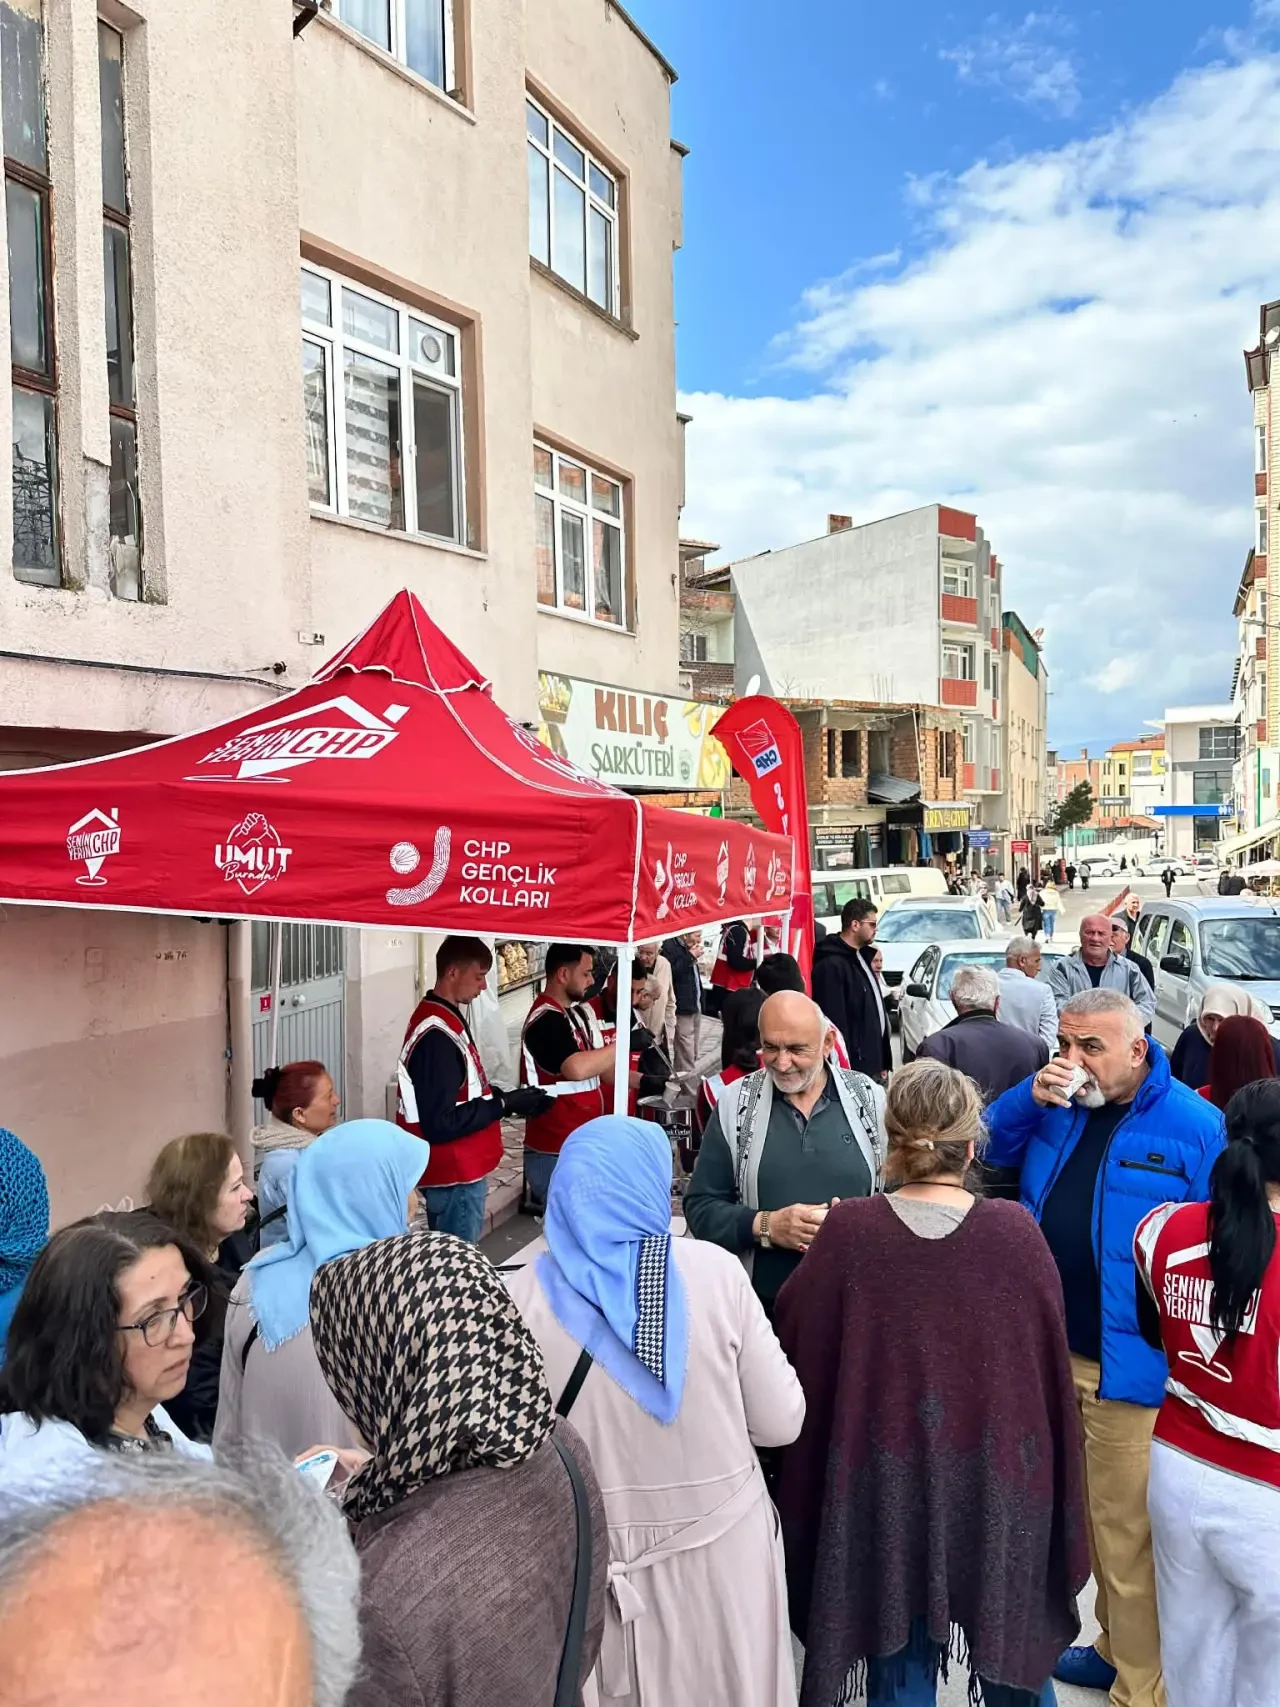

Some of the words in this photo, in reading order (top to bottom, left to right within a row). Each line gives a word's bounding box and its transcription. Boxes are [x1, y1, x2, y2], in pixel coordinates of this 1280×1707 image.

[594, 688, 669, 745] KILIÇ
[214, 728, 301, 753] SENİN
[288, 730, 386, 755] CHP
[589, 740, 675, 779] ŞARKÜTERİ
[66, 832, 92, 849] SENİN
[92, 831, 118, 854] CHP
[463, 839, 511, 859] CHP
[215, 844, 293, 873] UMUT
[221, 861, 283, 881] Burada!
[674, 853, 688, 869] CHP
[461, 862, 558, 888] GENÇLİK
[459, 885, 551, 909] KOLLARI
[1163, 1272, 1205, 1302] SENİN
[1163, 1295, 1204, 1324] YERİN
